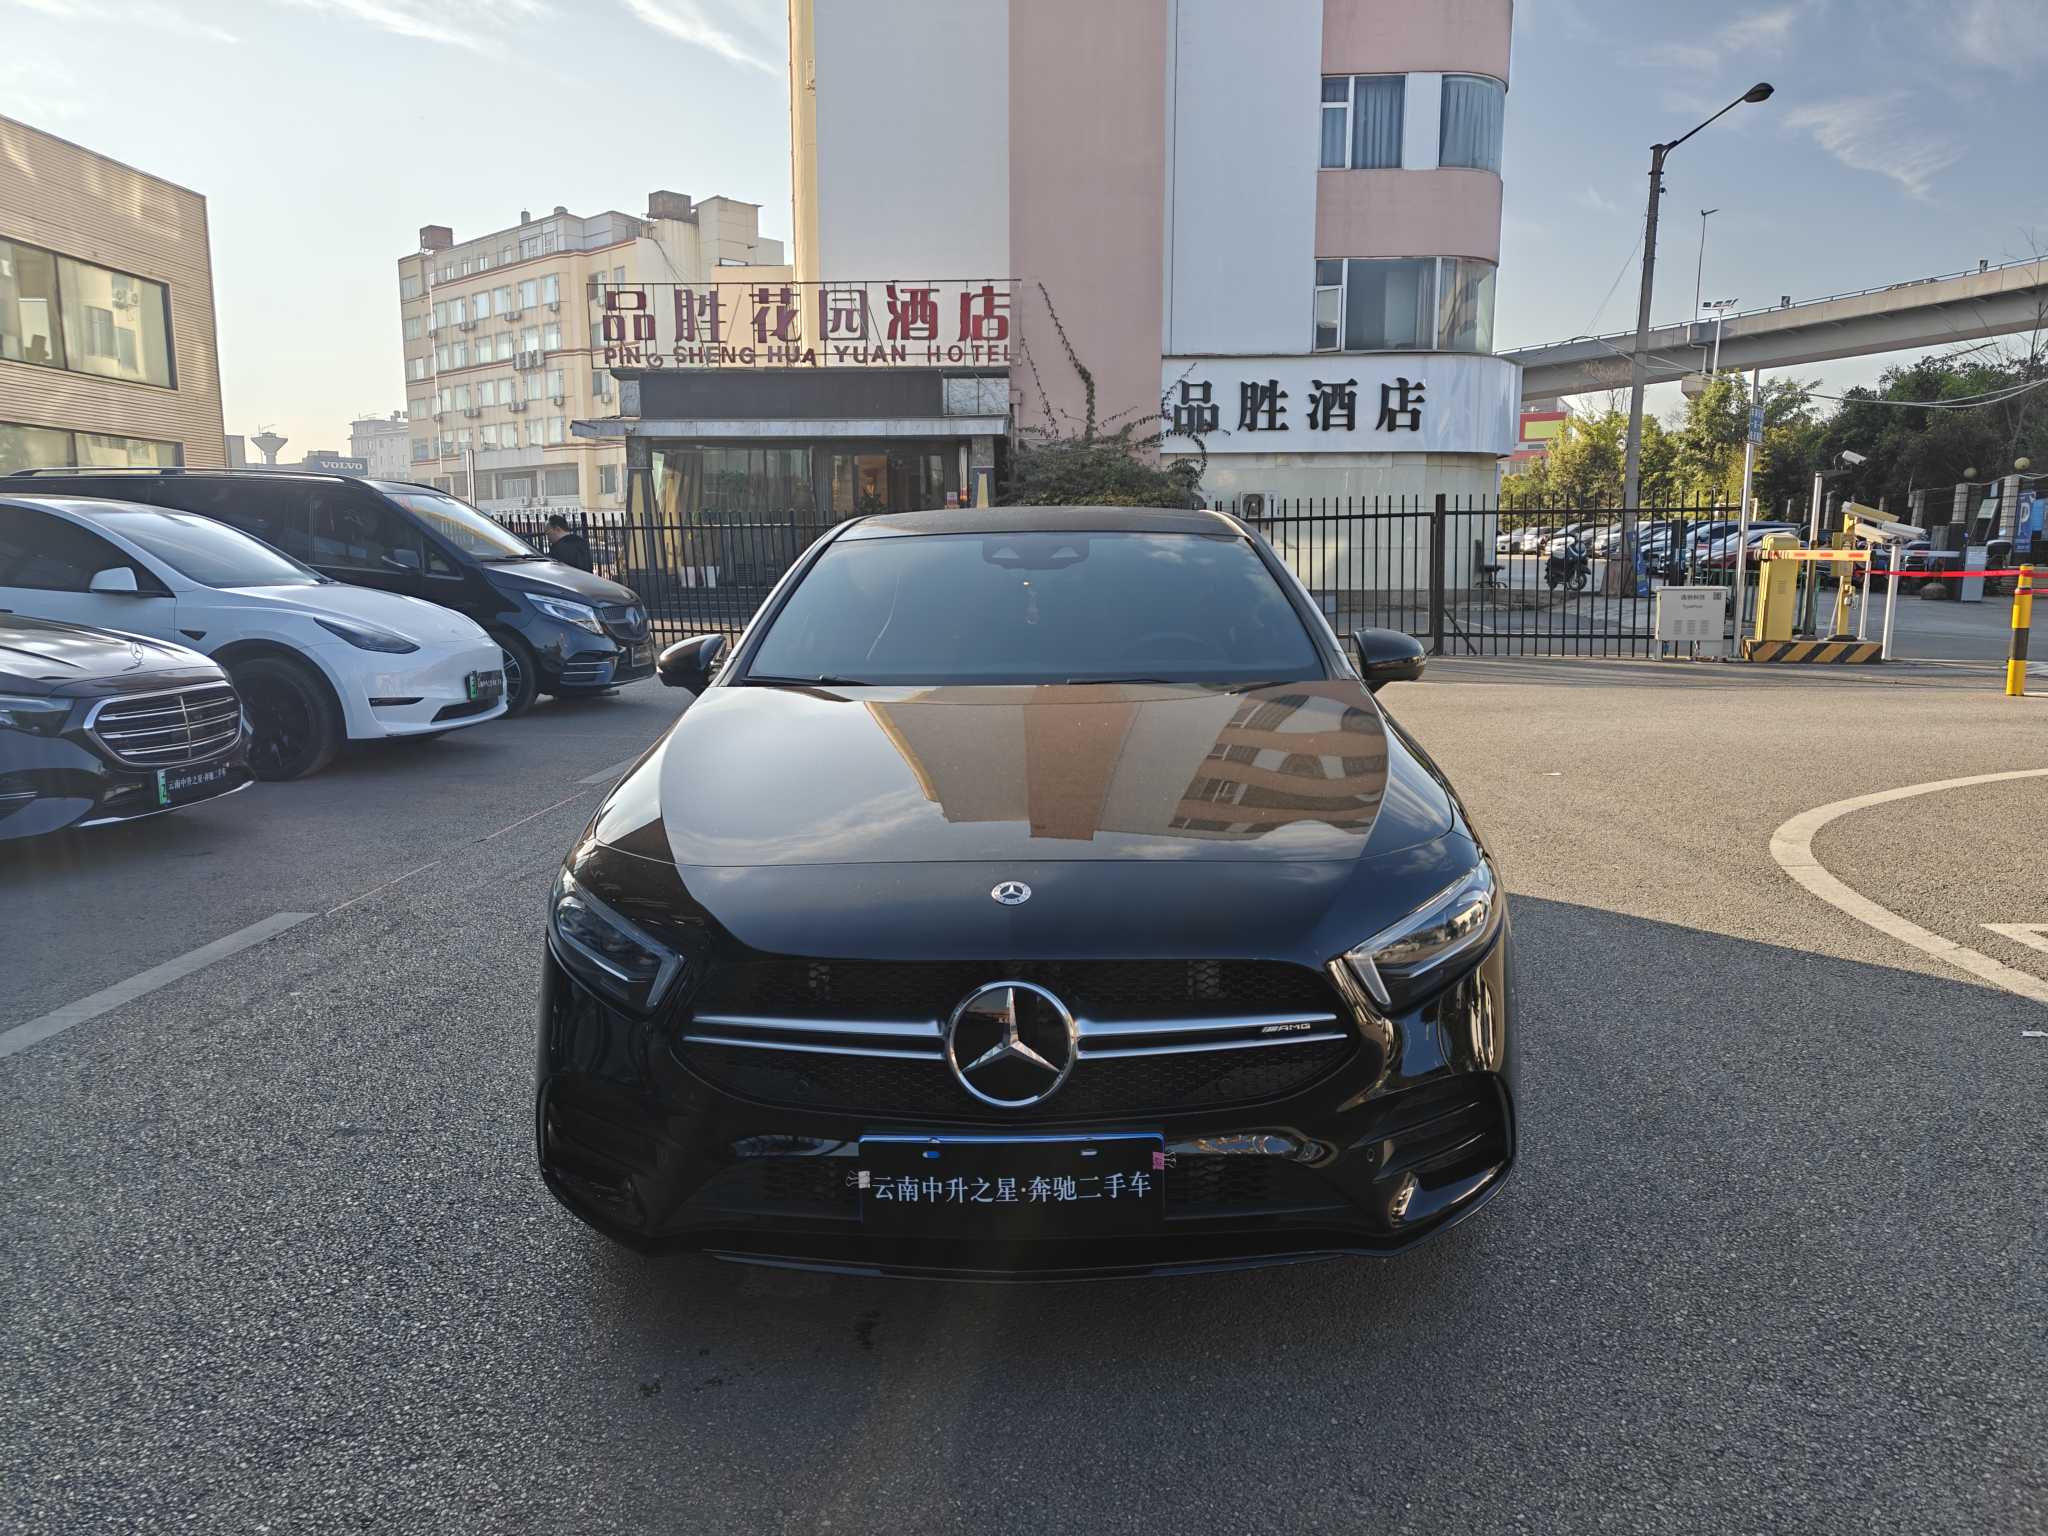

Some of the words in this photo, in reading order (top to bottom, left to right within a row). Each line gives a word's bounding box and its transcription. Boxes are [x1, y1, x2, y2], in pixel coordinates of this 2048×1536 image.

[603, 285, 1010, 343] 品胜花园酒店
[604, 346, 664, 369] PING
[673, 346, 755, 364] SHENG
[768, 346, 817, 368] HUA
[833, 345, 906, 364] YUAN
[928, 344, 1013, 364] HOTEL
[1173, 377, 1426, 432] 品胜酒店
[321, 461, 363, 470] VOLVO
[1276, 1023, 1311, 1032] AMG
[872, 1171, 1151, 1203] 云南中升之星·奔驰二手车
